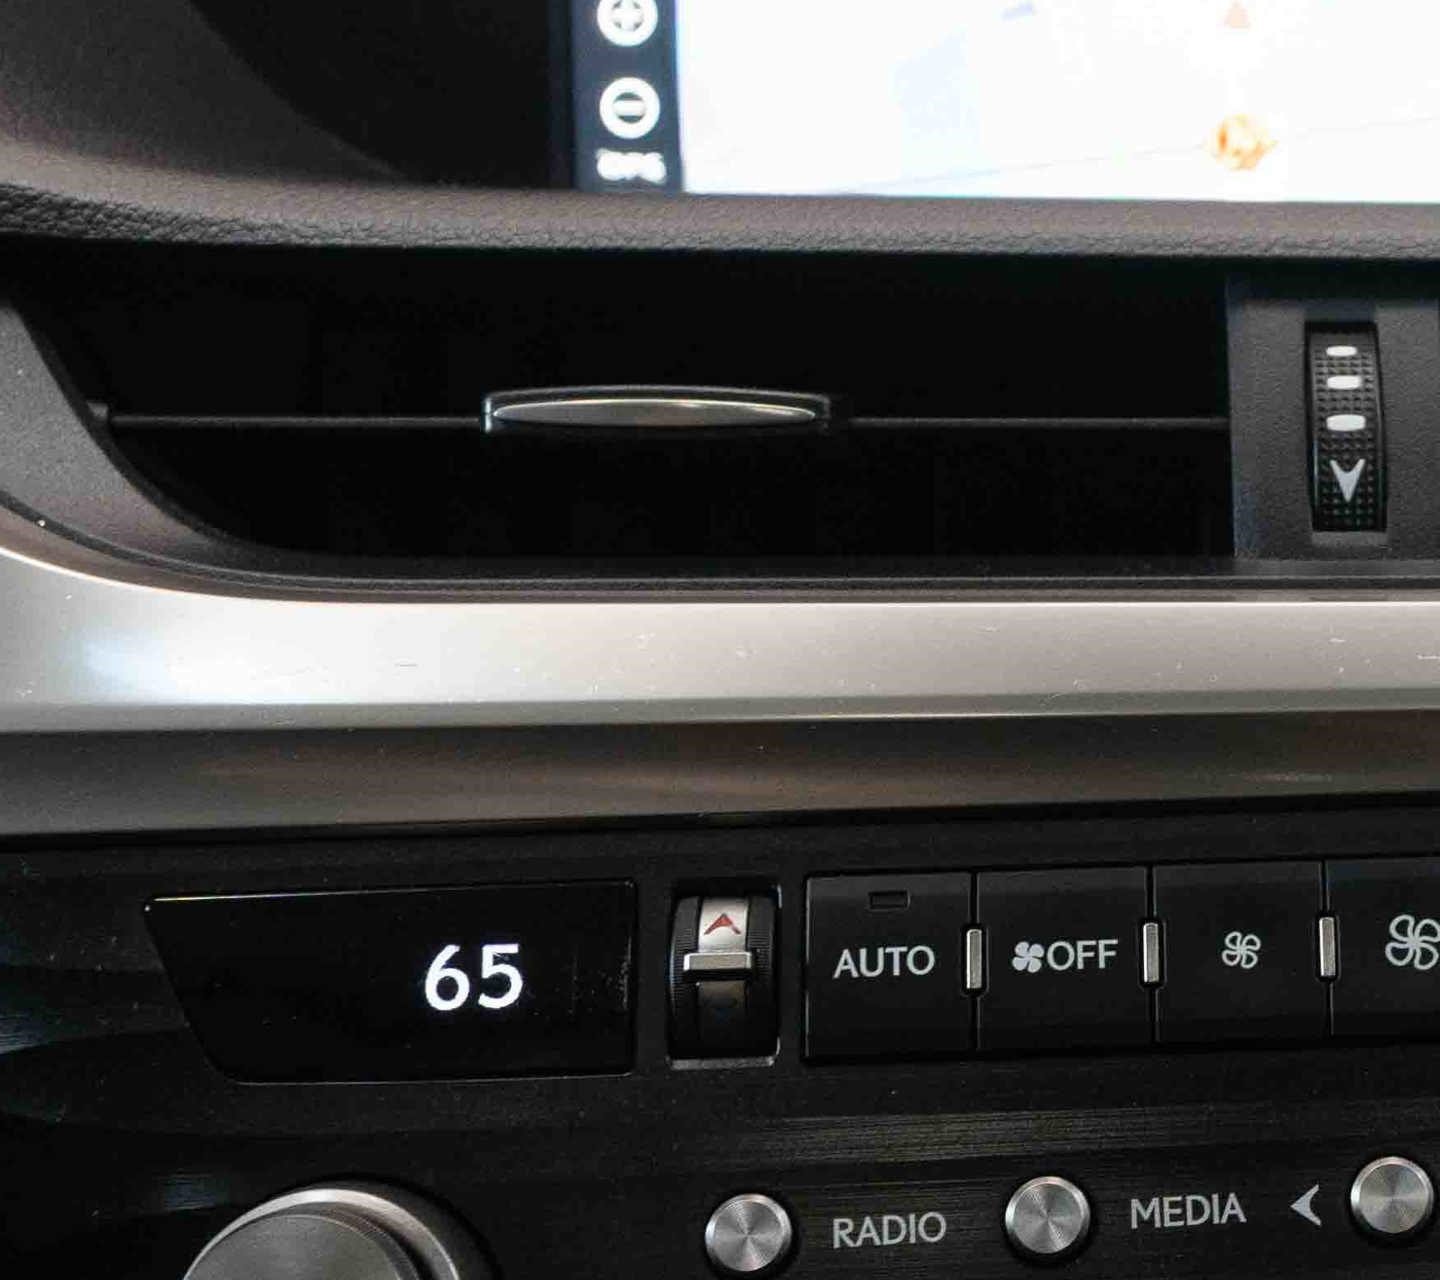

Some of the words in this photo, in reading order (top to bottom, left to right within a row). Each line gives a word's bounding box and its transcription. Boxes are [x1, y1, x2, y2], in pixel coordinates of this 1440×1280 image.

[833, 945, 936, 979] AUTO
[1046, 938, 1119, 971] OFF
[424, 943, 524, 1011] 65
[1130, 1192, 1247, 1229] MEDIA
[832, 1211, 947, 1249] RADIO
